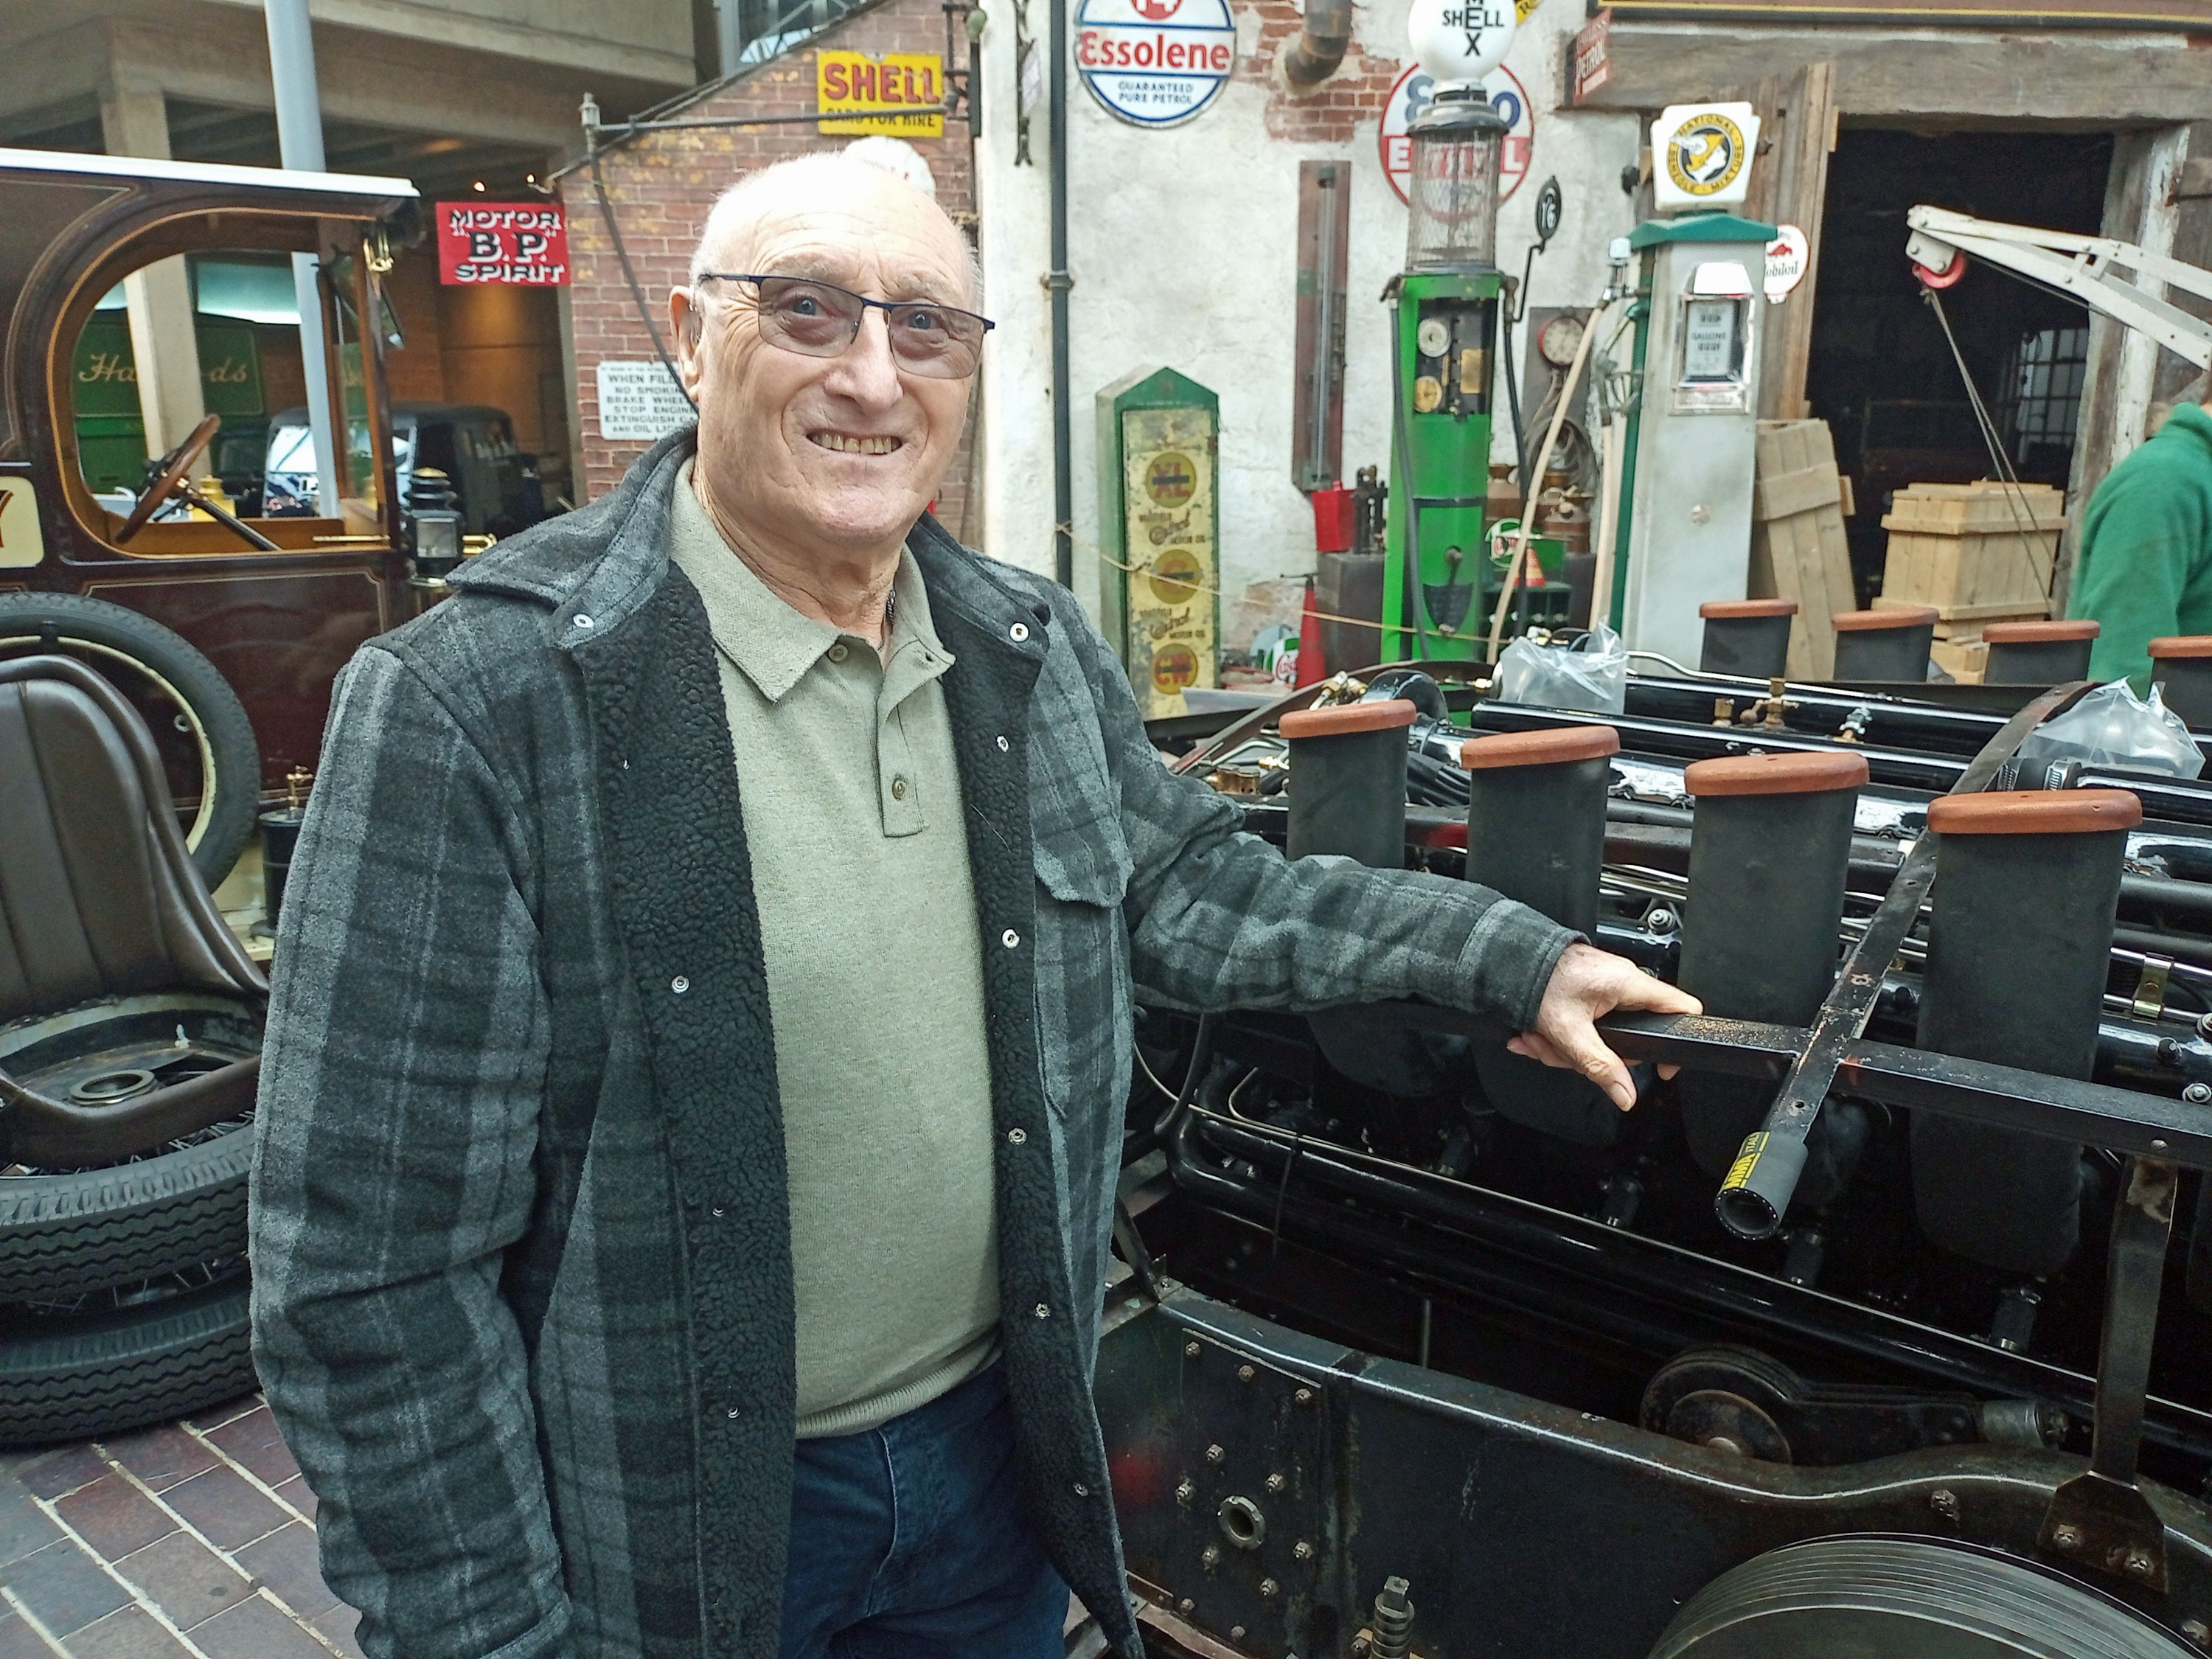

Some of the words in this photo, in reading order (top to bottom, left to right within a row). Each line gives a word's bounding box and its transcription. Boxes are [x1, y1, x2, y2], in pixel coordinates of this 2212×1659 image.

[1442, 7, 1504, 30] SHELL
[1079, 31, 1229, 70] Essolene
[824, 63, 941, 104] SHELL
[1118, 80, 1194, 94] GUARANTEED
[1118, 93, 1148, 103] PURE
[1152, 94, 1192, 105] PETROL
[450, 209, 562, 231] MOTOR
[455, 263, 565, 283] SPIRIT
[1765, 260, 1800, 277] obiloil
[78, 352, 248, 383] Hads
[608, 375, 644, 383] WHEN
[633, 425, 652, 434] OIL
